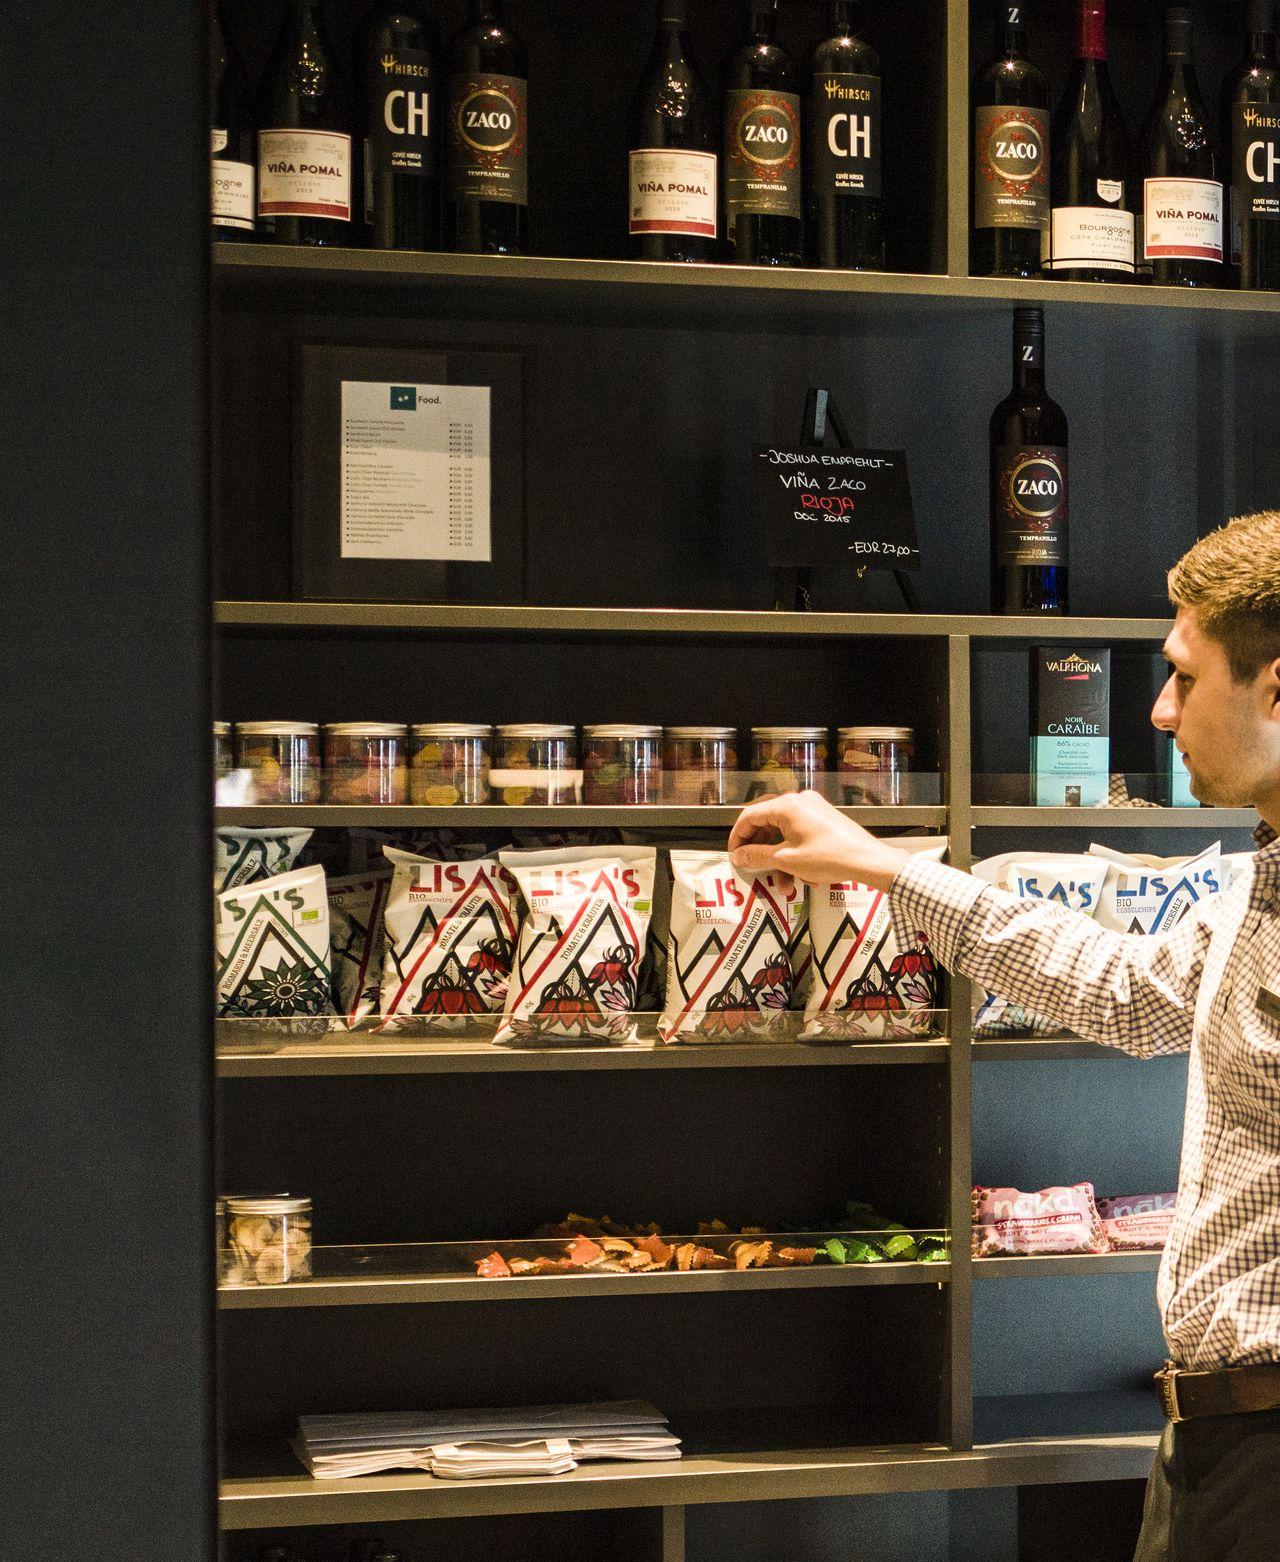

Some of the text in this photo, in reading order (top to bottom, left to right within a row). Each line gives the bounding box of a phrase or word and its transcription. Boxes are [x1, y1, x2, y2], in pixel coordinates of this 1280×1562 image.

[1008, 7, 1019, 24] Z
[395, 64, 429, 77] HIRSCH
[838, 89, 870, 101] HIRSCH
[383, 90, 429, 137] CH
[466, 111, 511, 130] ZACO
[745, 125, 788, 144] ZACO
[827, 113, 871, 158] CH
[996, 142, 1038, 160] ZACO
[267, 161, 342, 177] VIÑA POMAL
[637, 182, 708, 196] VIÑA POMAL
[1156, 207, 1219, 223] VIÑA POMAL
[1022, 345, 1033, 361] Z
[418, 396, 443, 405] Food.
[780, 472, 866, 490] VIÑA ZACO
[1017, 479, 1057, 496] ZACO
[801, 493, 855, 516] RIOJA
[794, 511, 818, 521] DOC
[1046, 661, 1102, 673] VALRHONA
[1047, 722, 1100, 735] CARAÏBE
[530, 867, 640, 897] LISA'S
[1116, 868, 1219, 897] LISA'S
[531, 898, 548, 908] BIO
[829, 892, 845, 901] BIO
[1116, 898, 1132, 907] BIO
[695, 909, 712, 918] BIO
[1116, 906, 1157, 914] KESSELCHIPS
[1162, 898, 1183, 933] MEERSALZ
[439, 923, 459, 951] TOMATE
[560, 934, 581, 960] TOMATE
[582, 898, 604, 929] KRÄUTER
[723, 943, 742, 971] TOMATE
[743, 907, 763, 938] KRÄUTER
[222, 959, 244, 990] ROSMARIN
[244, 918, 264, 953] MEERSALZ
